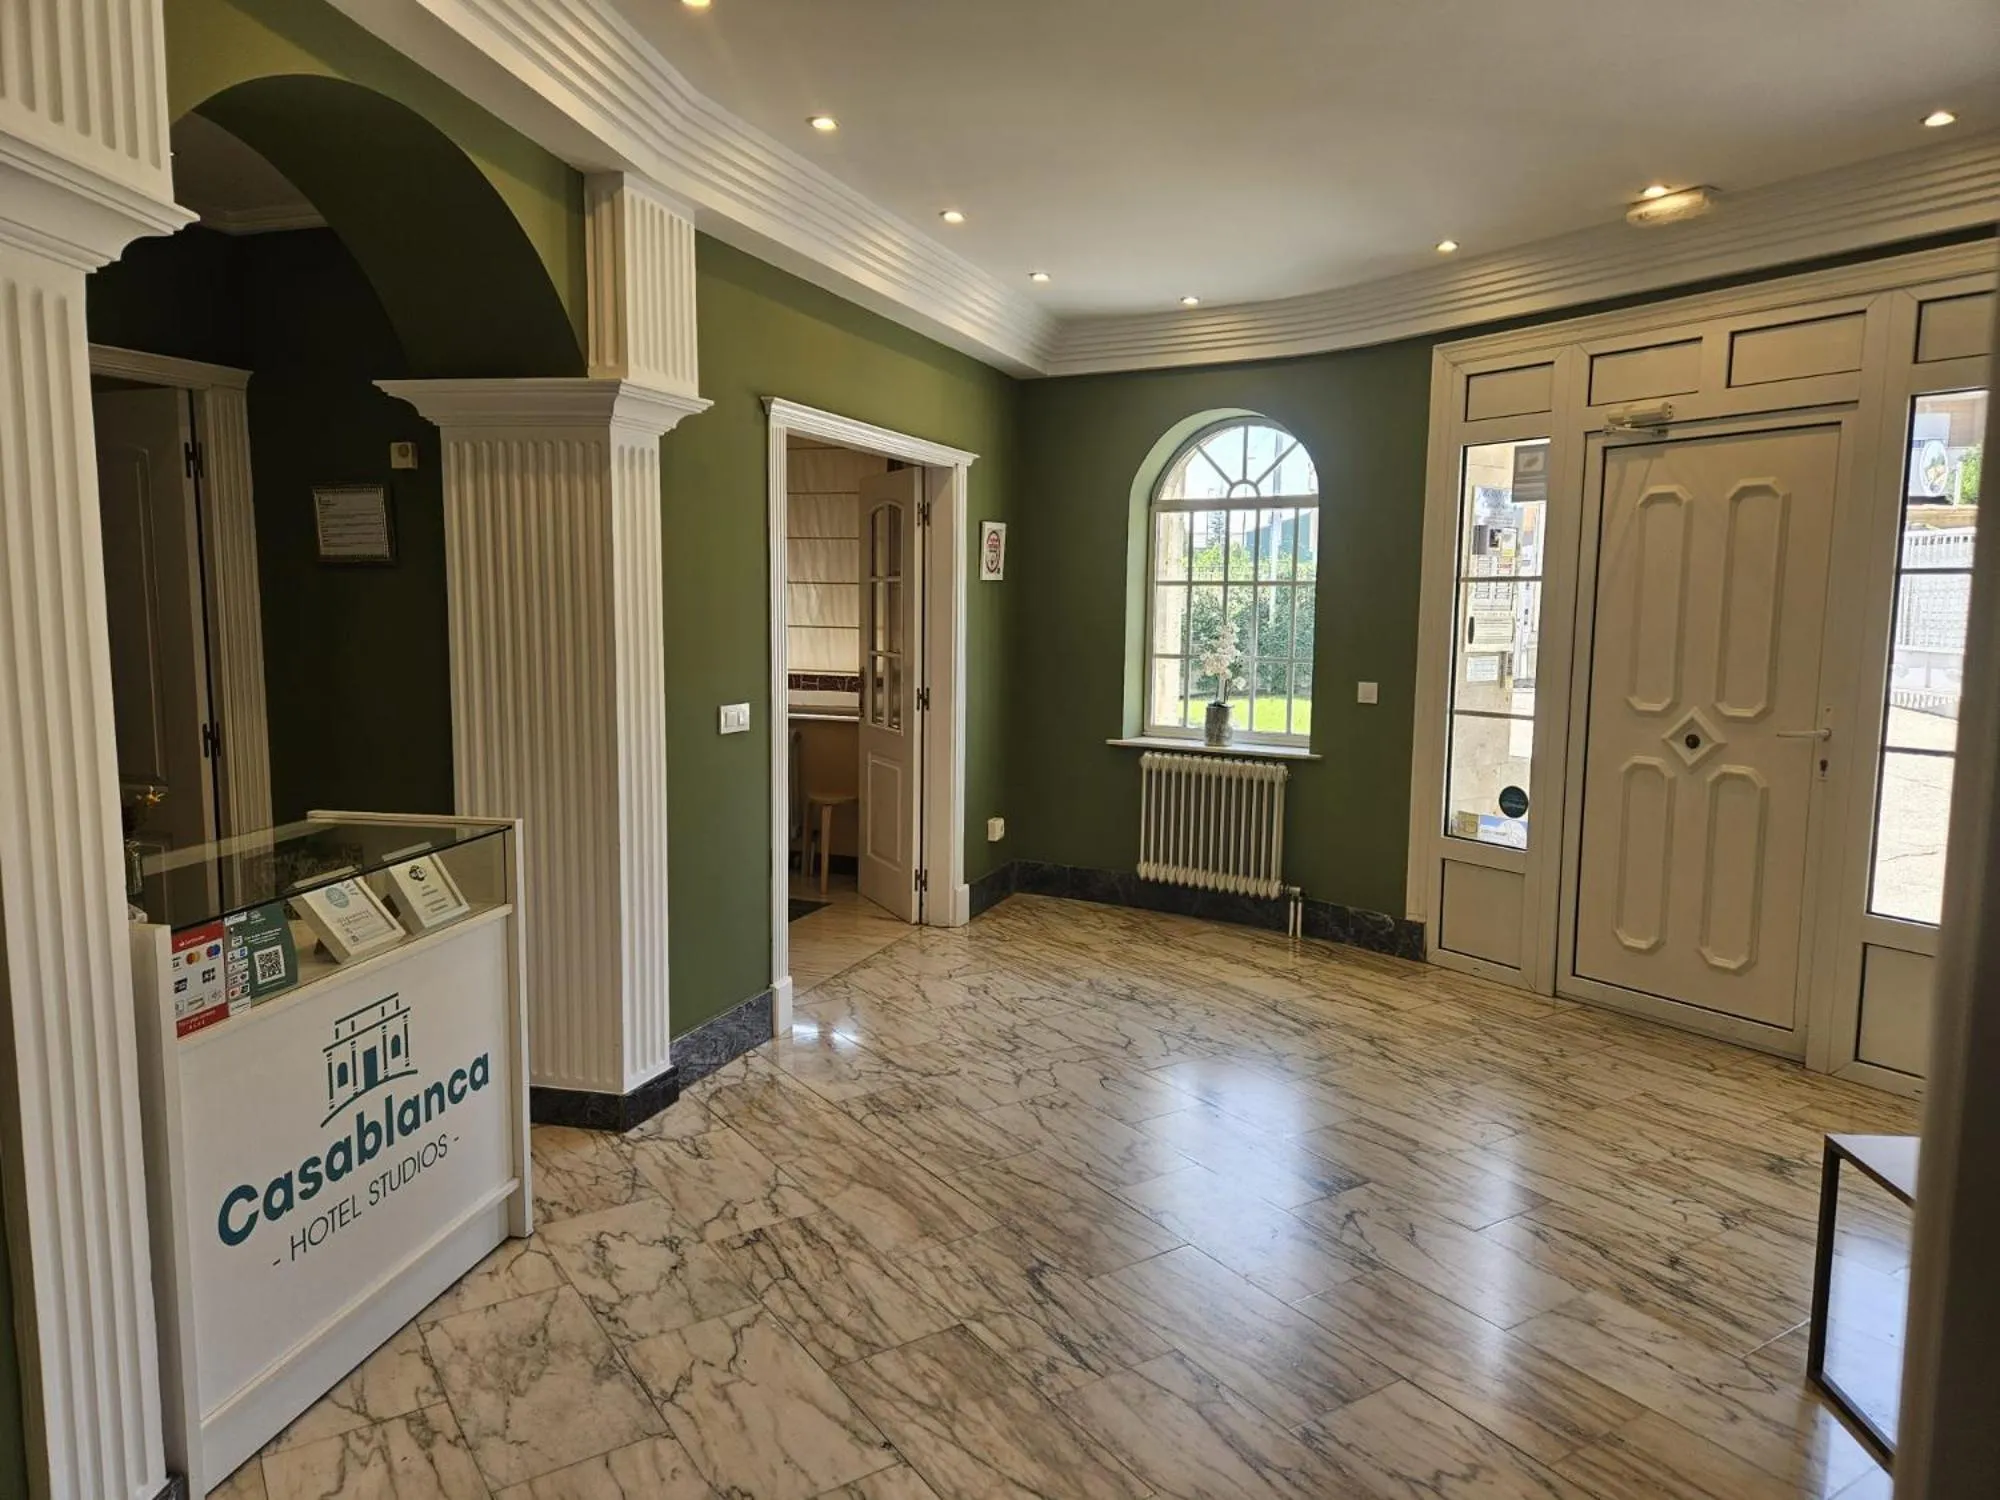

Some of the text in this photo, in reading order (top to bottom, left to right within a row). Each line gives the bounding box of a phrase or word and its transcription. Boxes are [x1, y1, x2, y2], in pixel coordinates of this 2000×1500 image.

[218, 1052, 489, 1247] Casablanca
[290, 1194, 362, 1262] HOTEL
[368, 1133, 448, 1206] STUDIOS
